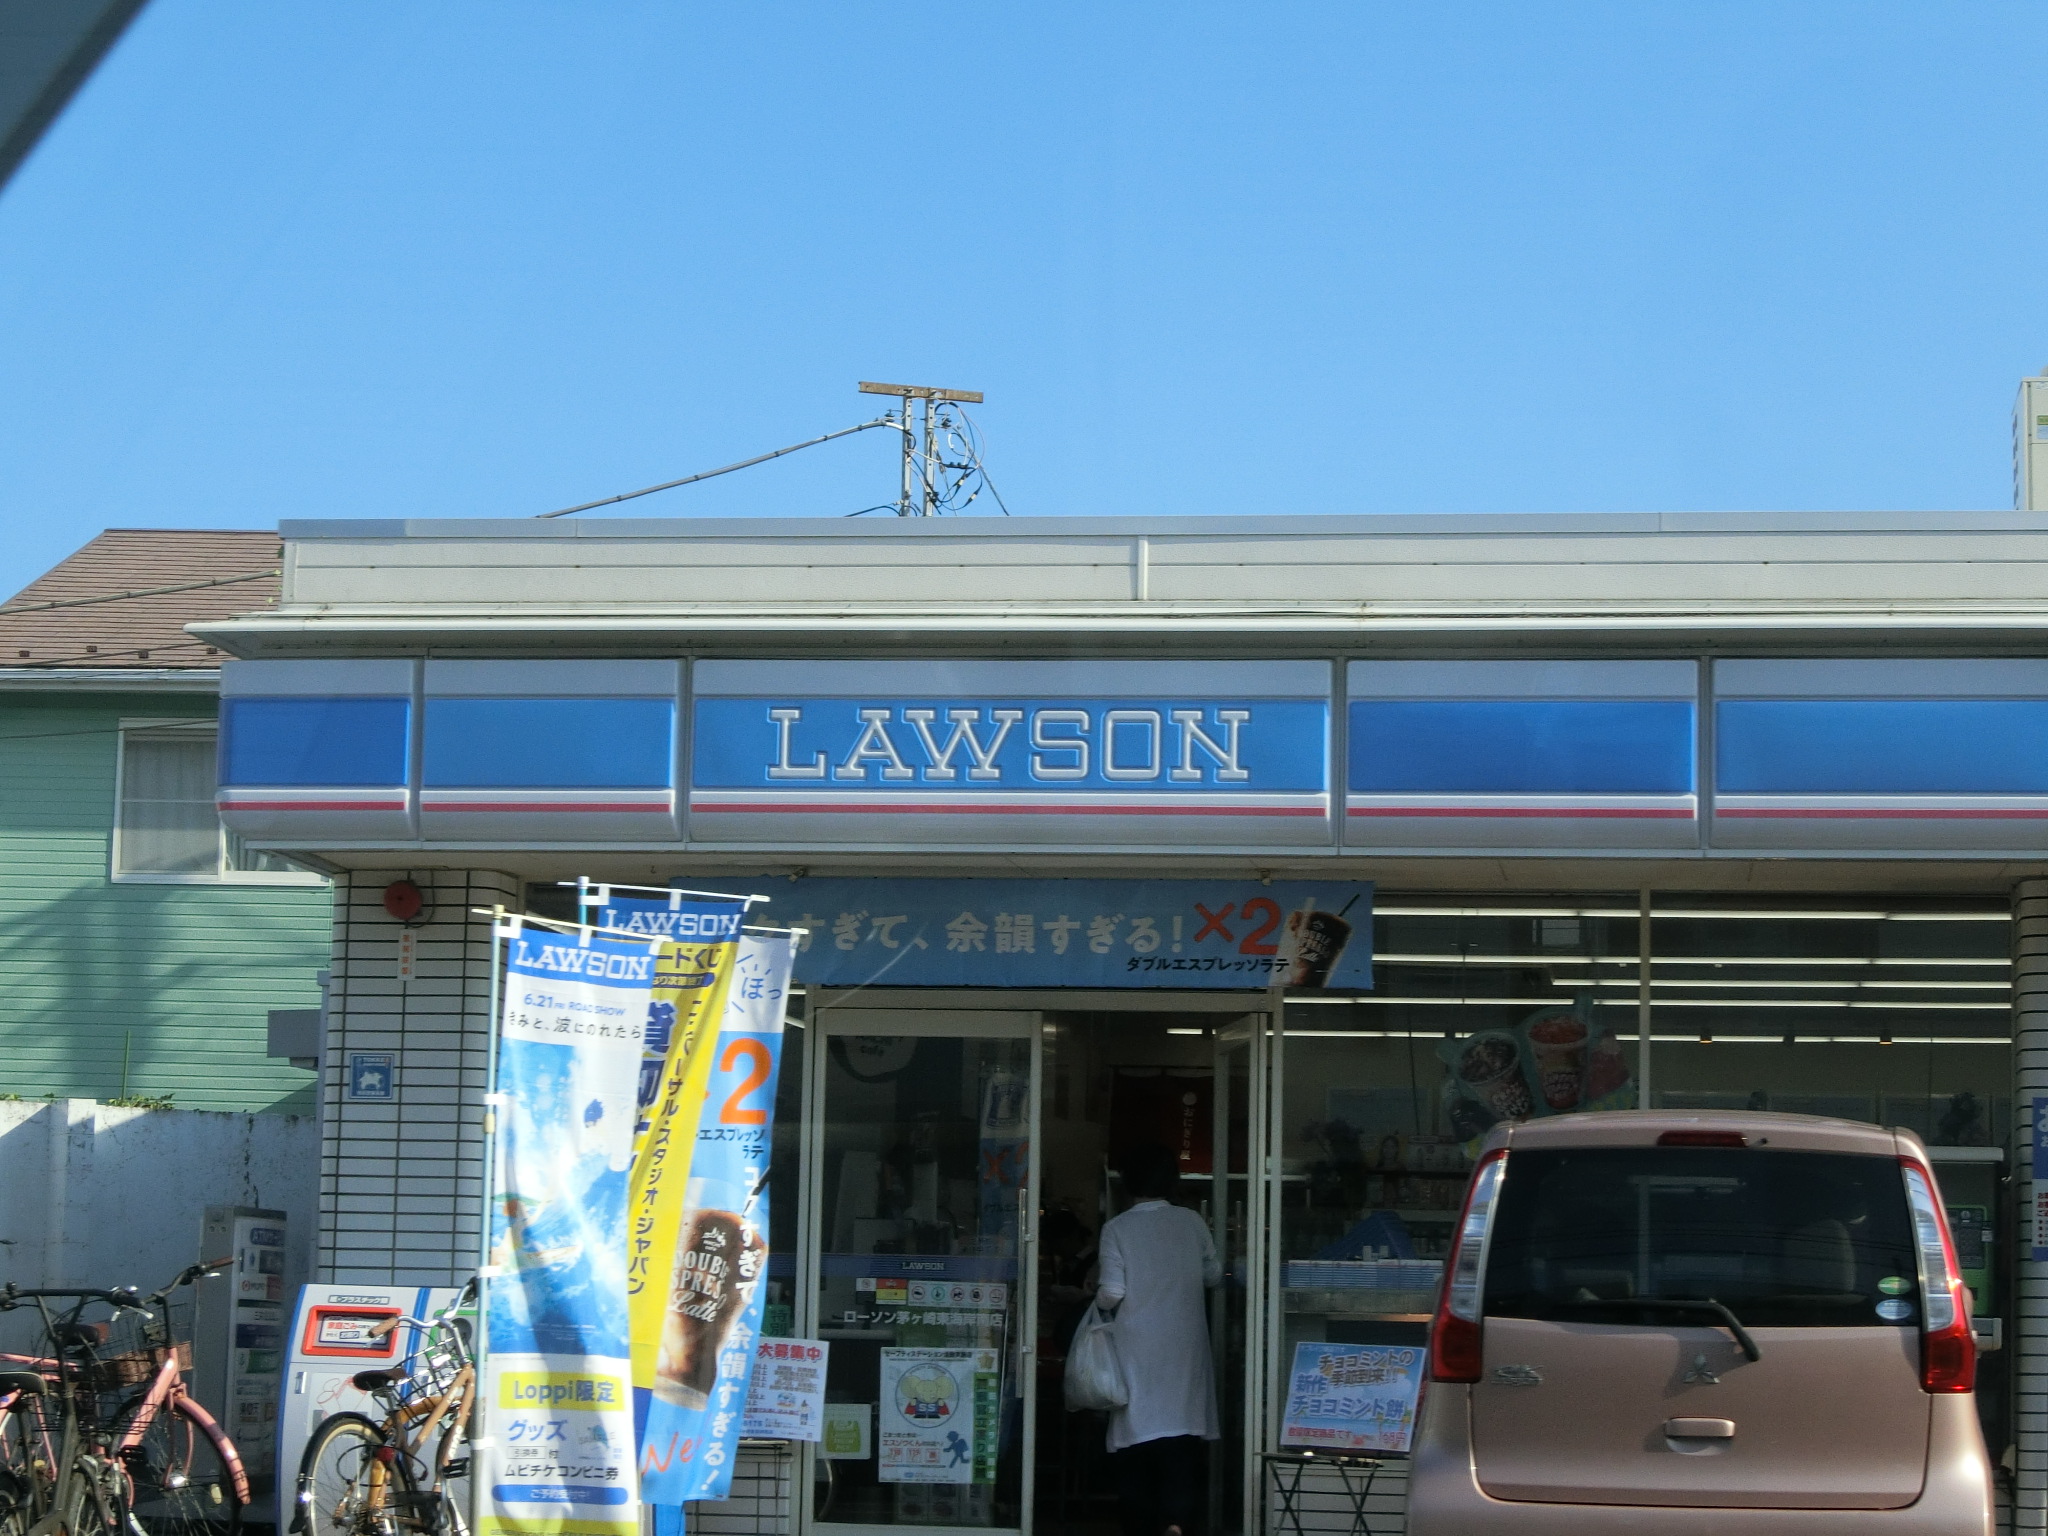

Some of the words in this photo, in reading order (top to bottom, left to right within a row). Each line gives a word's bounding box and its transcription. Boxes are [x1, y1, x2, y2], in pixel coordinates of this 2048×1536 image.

[765, 706, 1251, 782] LAWSON
[604, 907, 742, 938] LAWSON
[514, 940, 650, 982] LAWSON
[523, 992, 553, 1009] 6.21
[508, 1010, 642, 1040] きみと、波にのれたら
[901, 1261, 945, 1271] LAWSON
[667, 1290, 718, 1323] Latte
[758, 1343, 823, 1363] 大募集中
[1319, 1349, 1414, 1372] チョコミントの
[513, 1379, 615, 1405] Loppi限定
[1295, 1373, 1328, 1394] 新作
[918, 1403, 936, 1412] SS
[1292, 1395, 1405, 1420] チョコミント餅
[508, 1418, 568, 1442] グッズ
[641, 1431, 703, 1476] Ne
[505, 1464, 619, 1481] ムビチケコンビニ券
